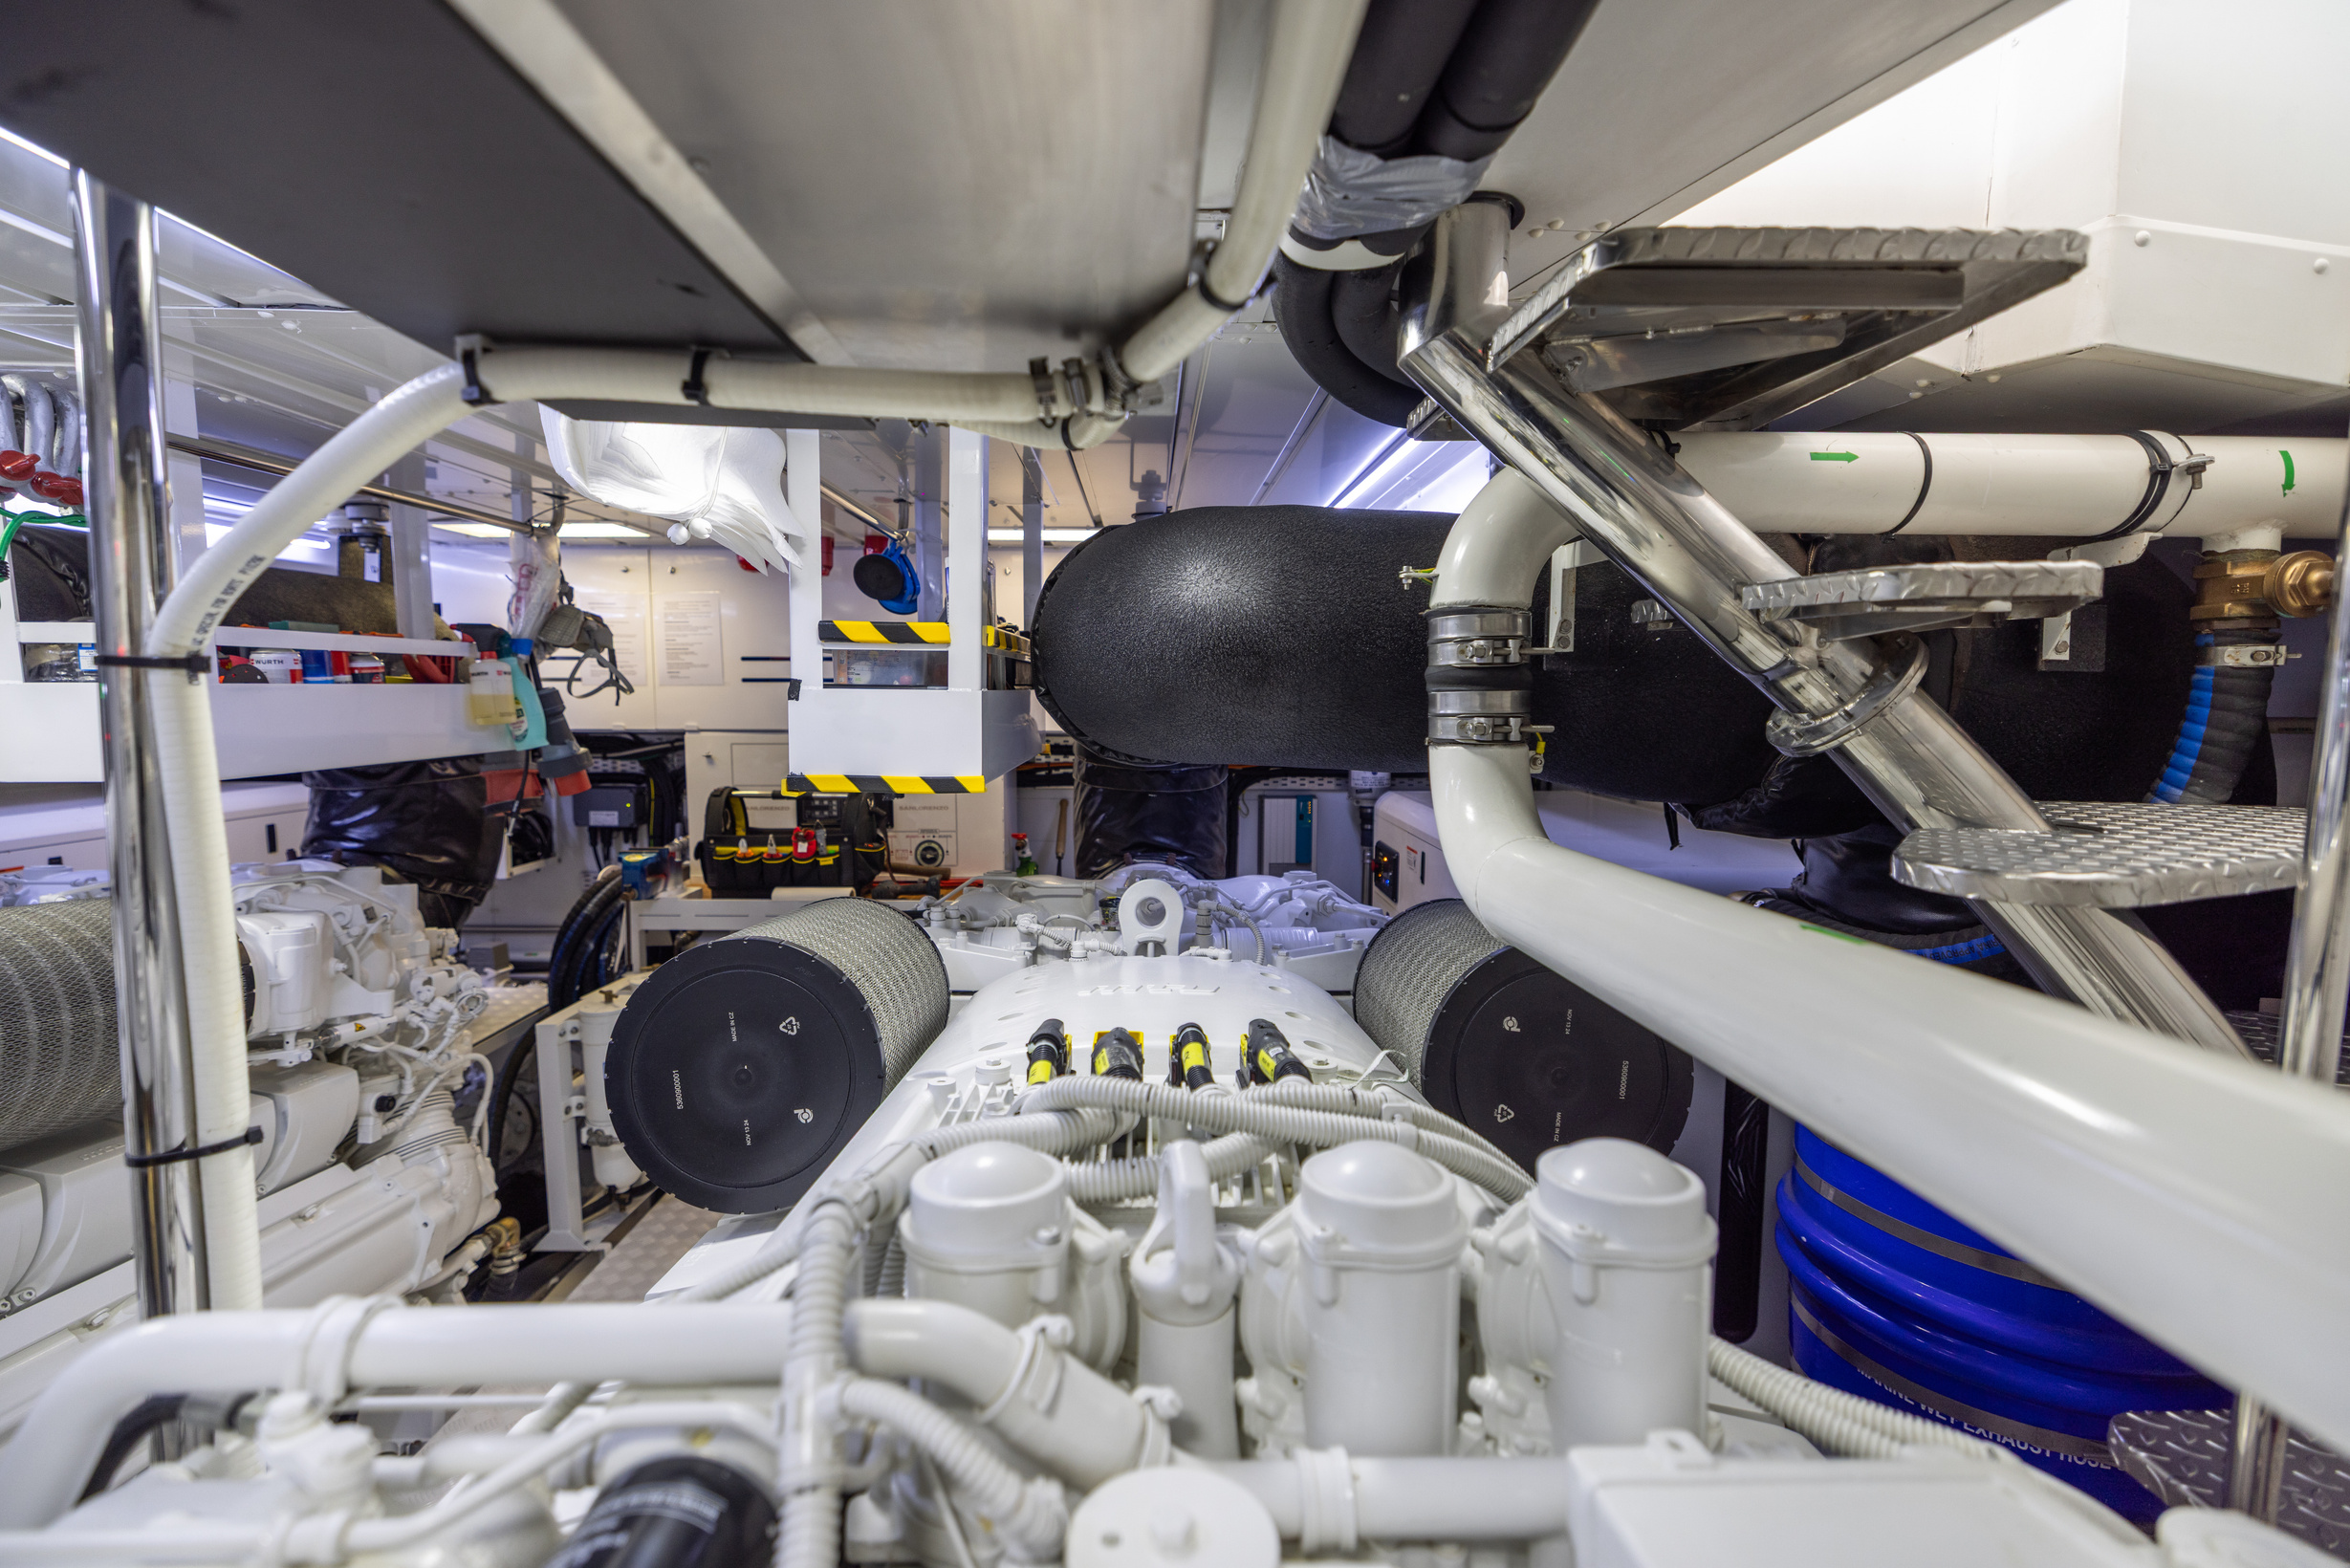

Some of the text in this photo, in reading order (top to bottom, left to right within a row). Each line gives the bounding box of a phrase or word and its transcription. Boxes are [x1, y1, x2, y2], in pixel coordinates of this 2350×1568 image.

[1929, 945, 1975, 961] APPROVED
[728, 1012, 734, 1020] CZ
[1554, 1134, 1559, 1143] CZ
